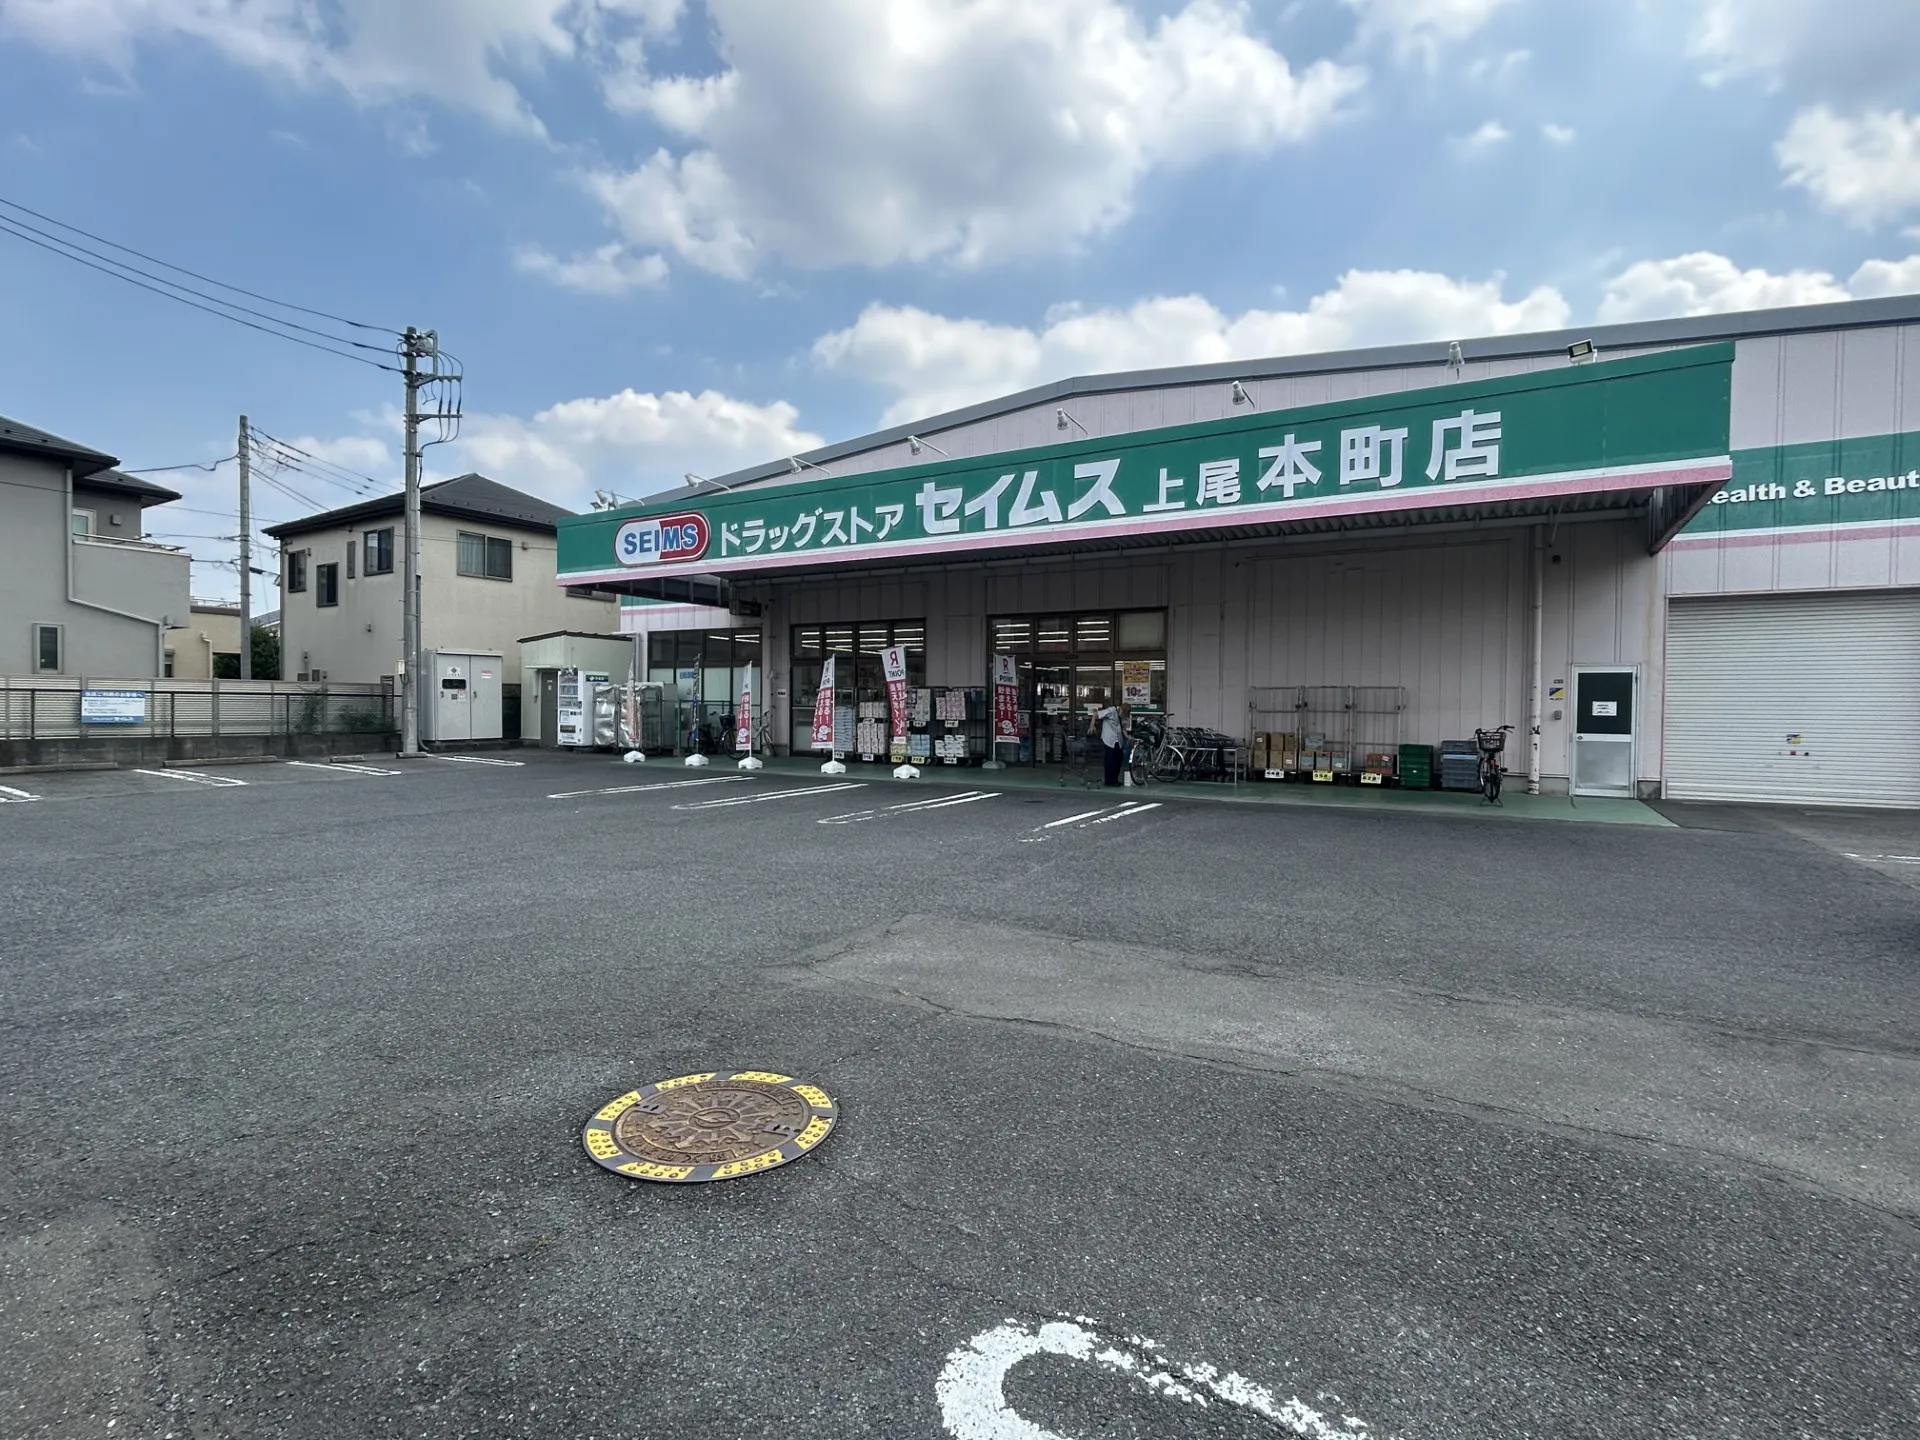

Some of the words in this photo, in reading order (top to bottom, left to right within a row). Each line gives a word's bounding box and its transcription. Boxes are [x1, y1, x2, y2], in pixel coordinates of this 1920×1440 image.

[721, 504, 904, 556] ドラッグストア
[916, 459, 1127, 534] セイムス
[1143, 409, 1502, 512] 上尾本町店
[1706, 483, 1786, 505] ealth
[1793, 479, 1816, 497] &
[624, 524, 698, 555] SEIMS
